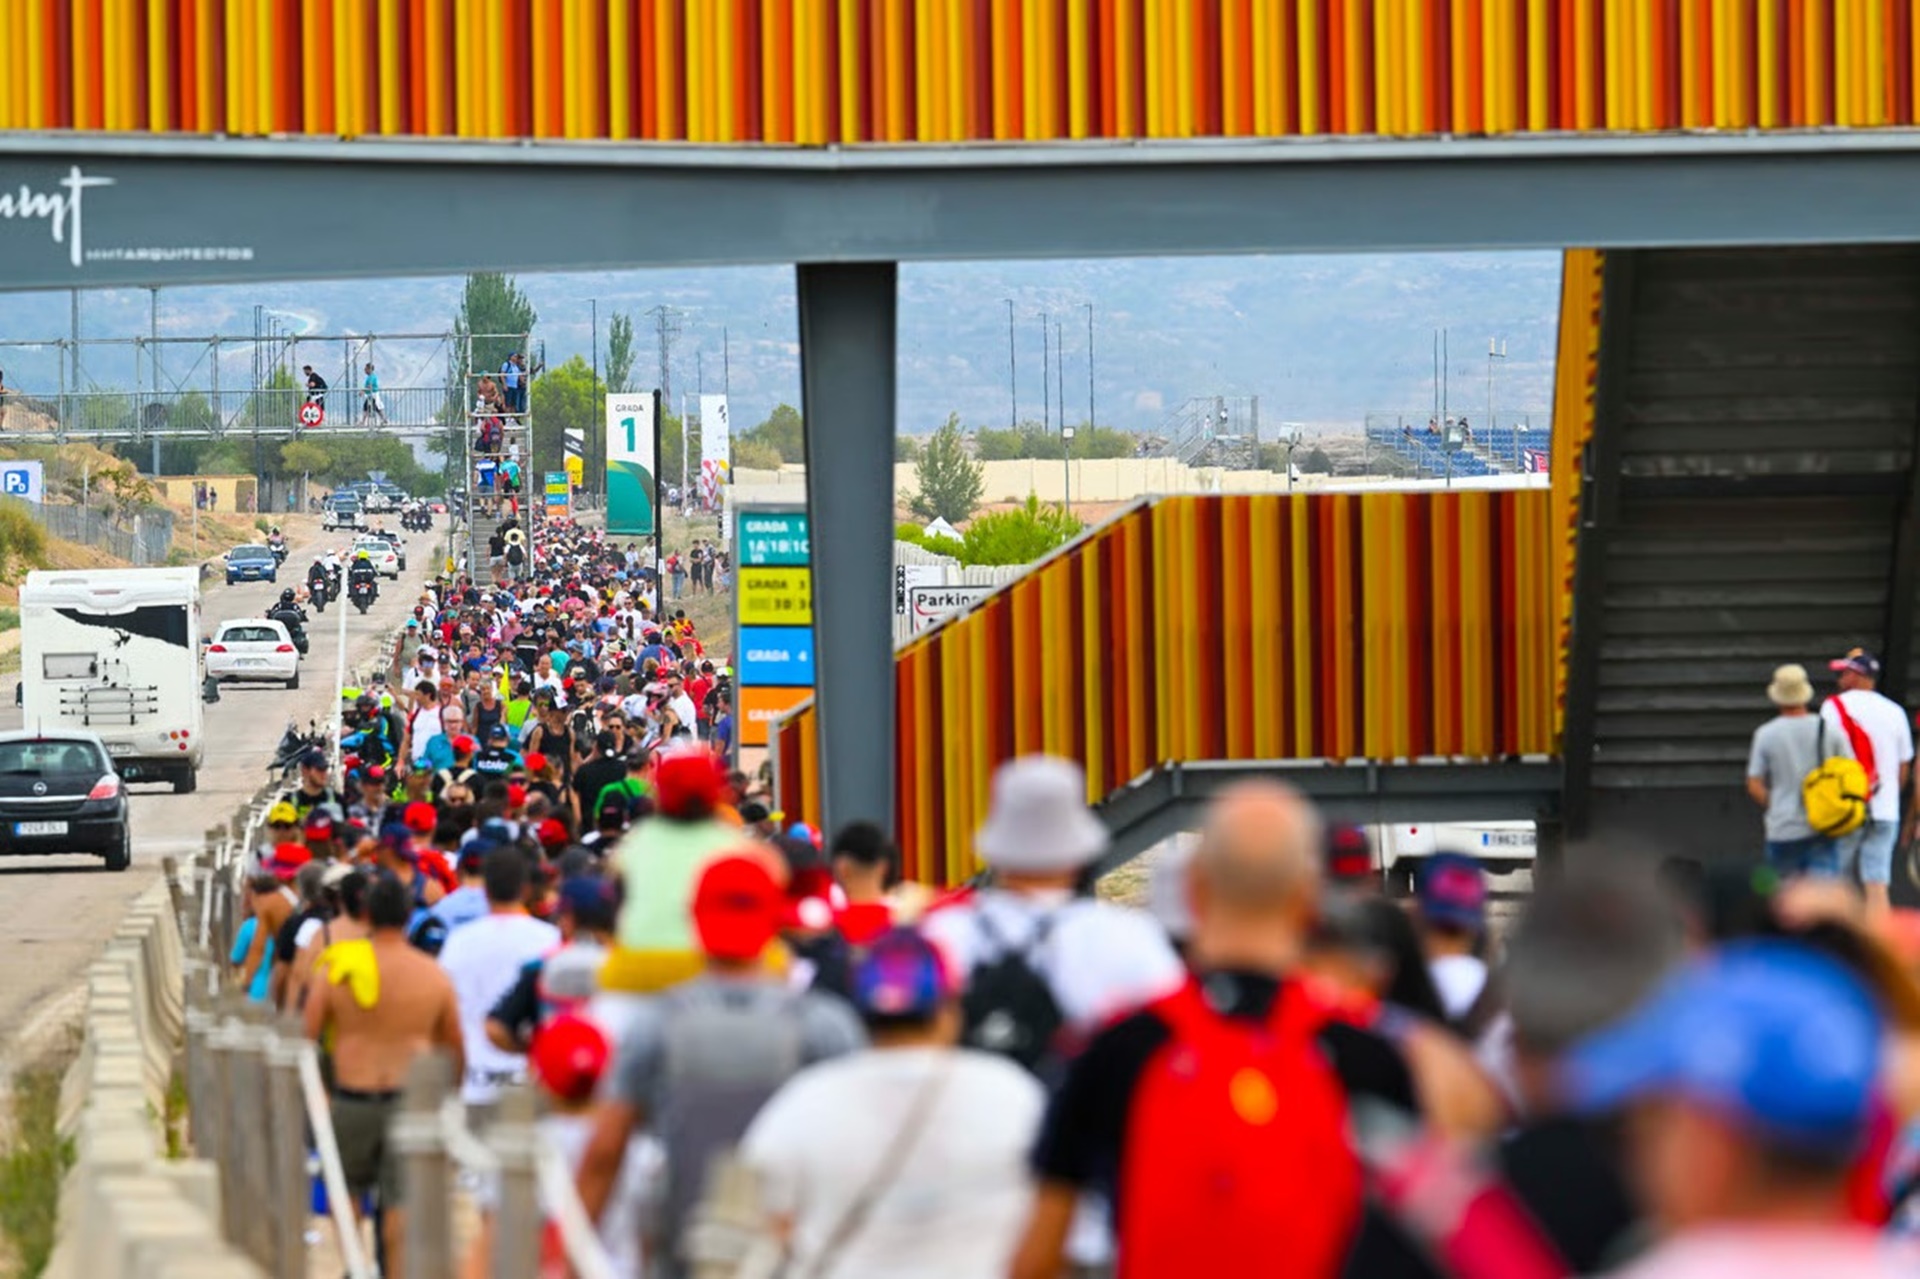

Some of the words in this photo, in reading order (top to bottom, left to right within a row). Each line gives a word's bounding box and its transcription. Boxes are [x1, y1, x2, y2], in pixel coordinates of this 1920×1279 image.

[615, 404, 644, 412] GRADA
[620, 417, 635, 452] 1
[746, 521, 789, 533] GRADA
[747, 579, 788, 590] GRADA
[746, 649, 790, 662] GRADA
